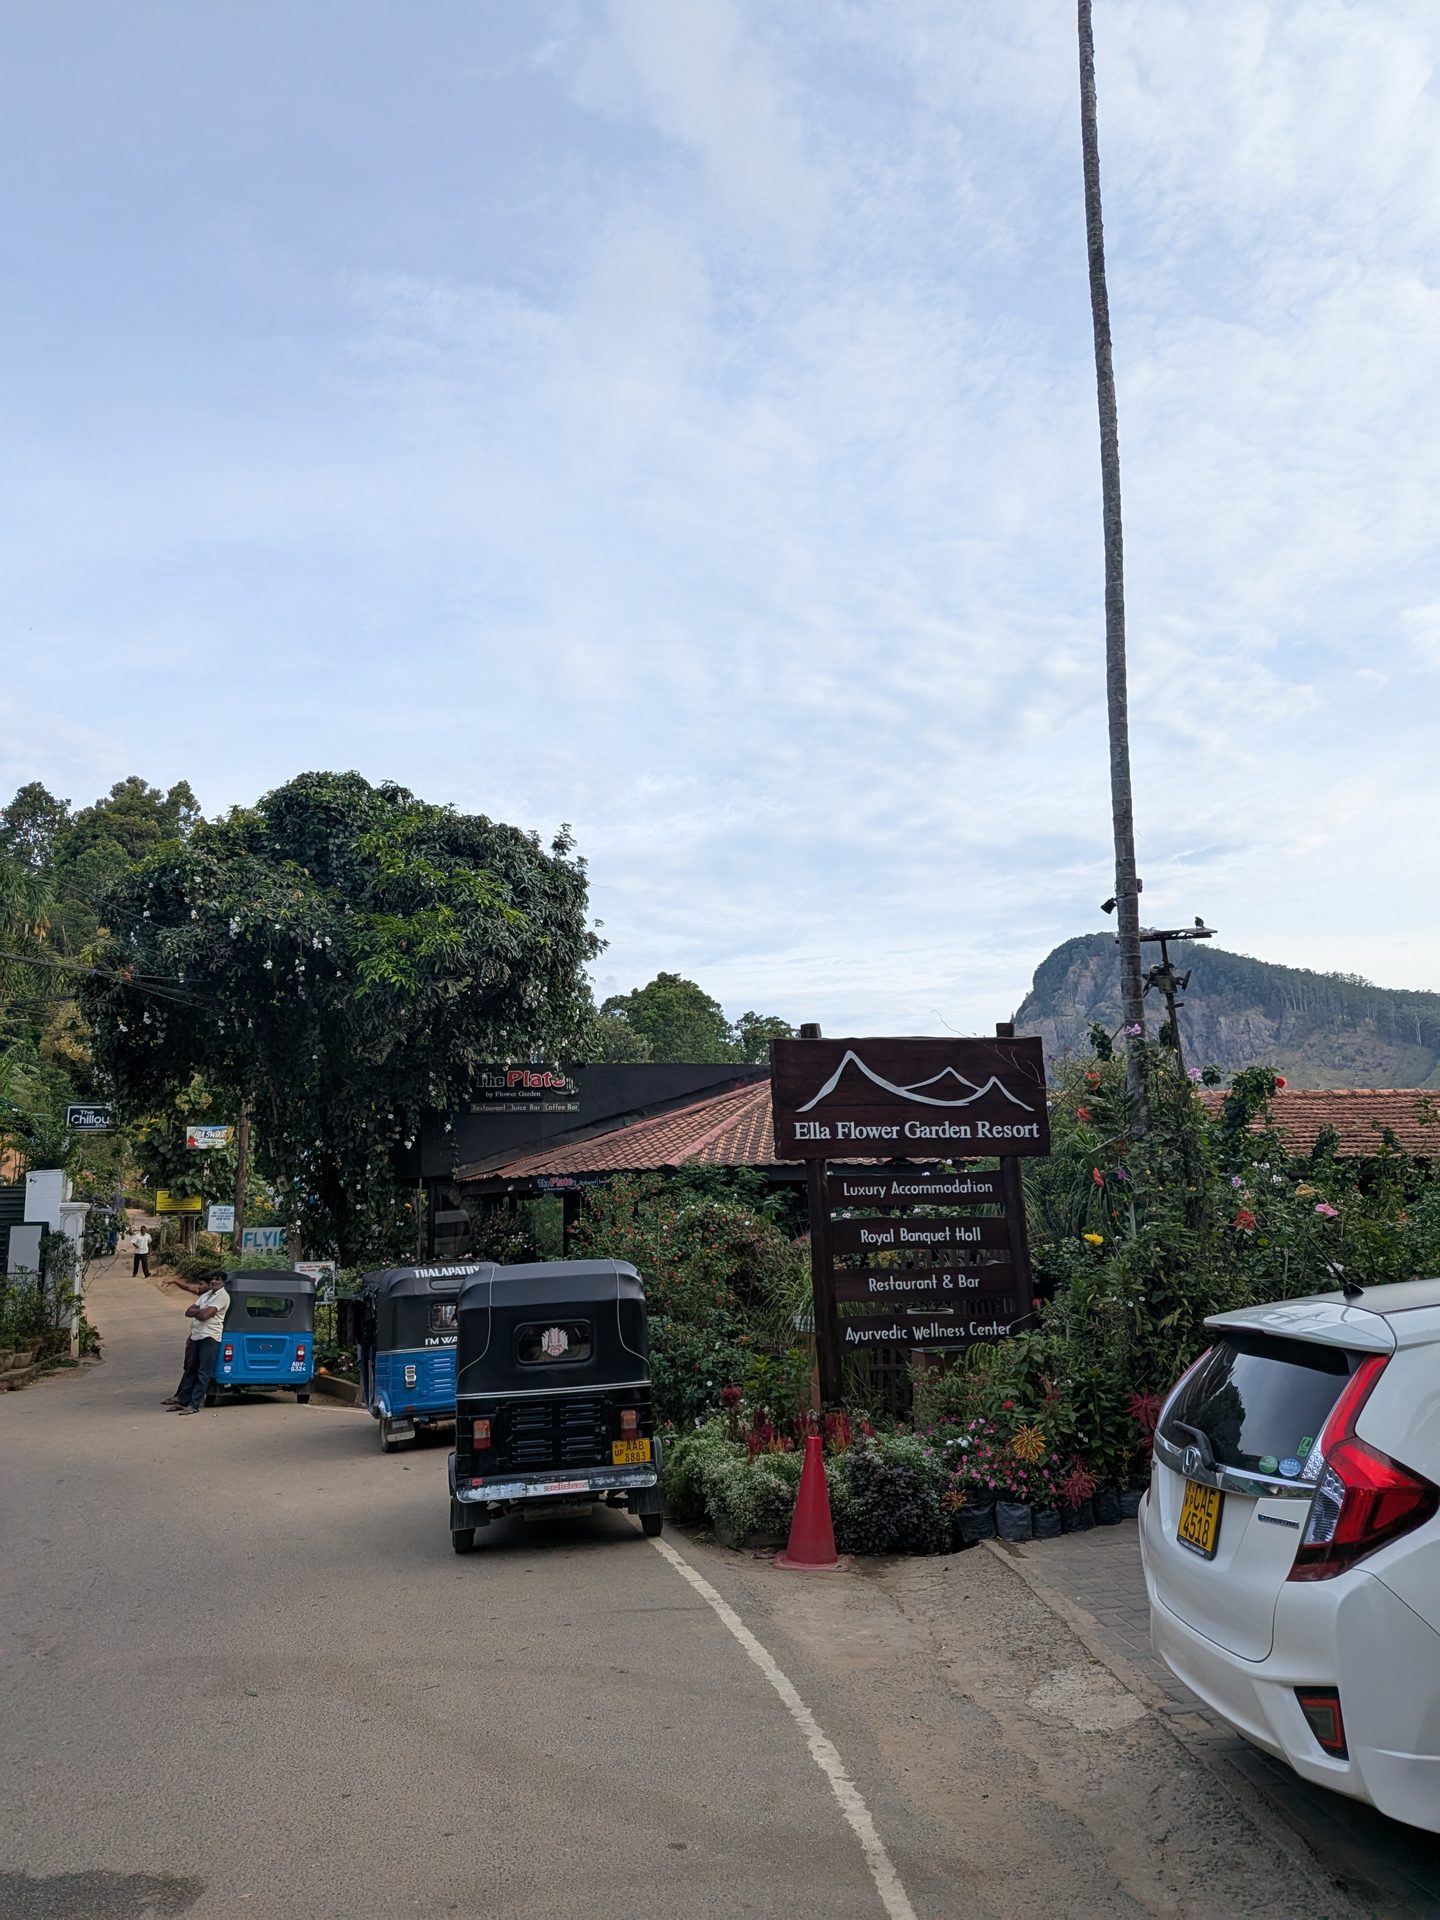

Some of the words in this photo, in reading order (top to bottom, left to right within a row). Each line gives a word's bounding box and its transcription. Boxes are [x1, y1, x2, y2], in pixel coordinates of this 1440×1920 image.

[529, 1103, 540, 1111] Bar
[545, 1103, 566, 1111] Coffee
[71, 1114, 110, 1125] Chillou
[793, 1121, 831, 1140] Ella
[836, 1121, 900, 1139] Flower
[904, 1120, 972, 1139] Garden
[975, 1120, 1040, 1138] Resort
[843, 1182, 887, 1198] Luxury
[890, 1179, 993, 1195] Accommodation
[860, 1228, 895, 1246] Royal
[900, 1226, 951, 1245] Banquet
[413, 1265, 480, 1279] THALAPATHY
[868, 1274, 937, 1292] Restaurant
[942, 1274, 954, 1289] &
[958, 1274, 980, 1288] Bar
[425, 1337, 440, 1346] I'M
[441, 1335, 458, 1345] WA
[845, 1324, 908, 1345] Ayurvedic
[912, 1322, 965, 1341] Wellness
[969, 1321, 1011, 1337] Center
[626, 1440, 645, 1452] AAB
[624, 1451, 646, 1462] 8883
[1193, 1485, 1217, 1519] CAE
[1183, 1510, 1211, 1547] 4518
